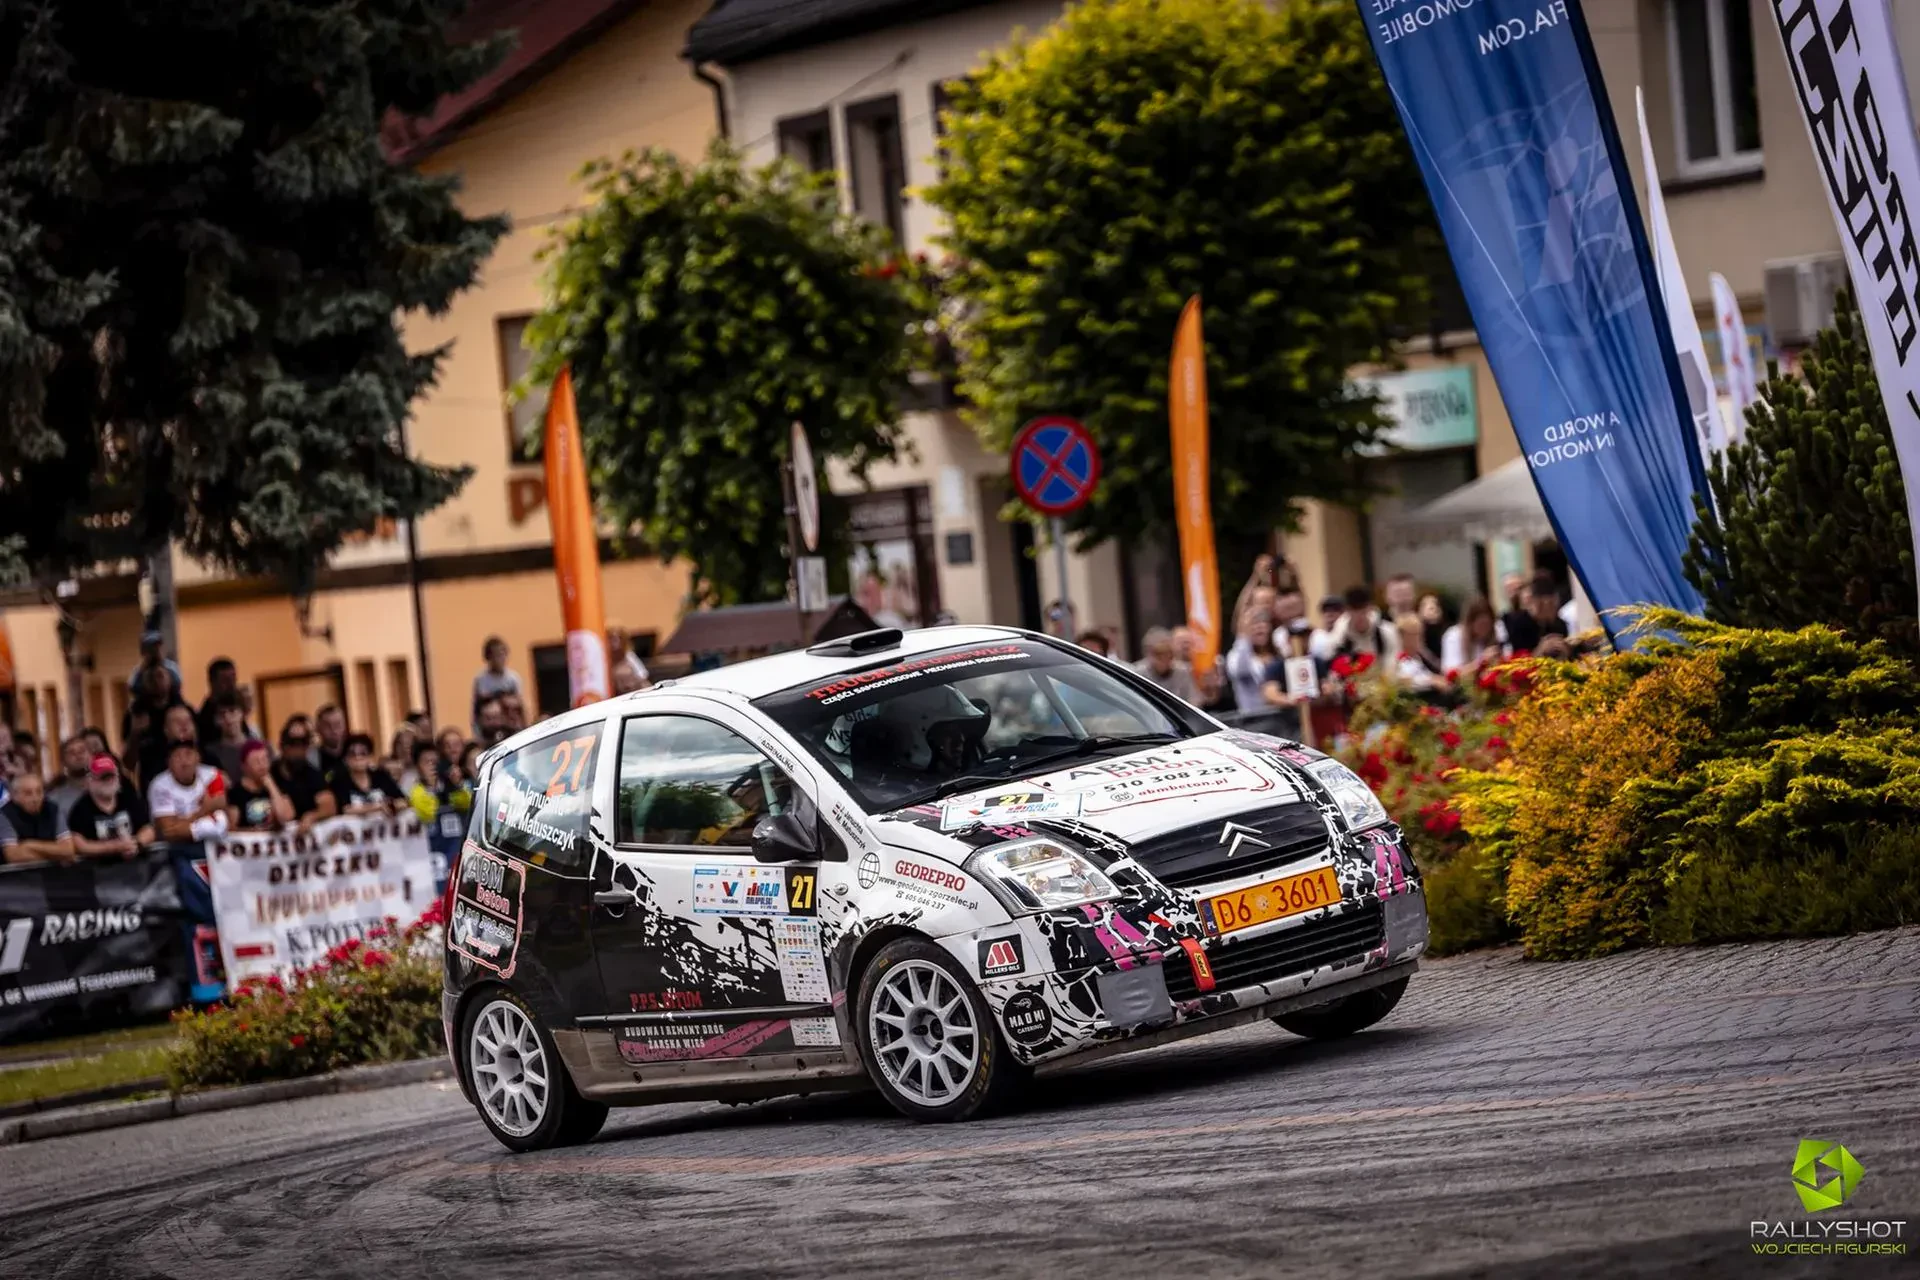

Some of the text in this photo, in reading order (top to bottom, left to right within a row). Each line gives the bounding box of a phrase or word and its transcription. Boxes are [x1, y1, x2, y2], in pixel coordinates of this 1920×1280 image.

[807, 668, 894, 698] TRUCK
[546, 734, 596, 798] 27
[1070, 755, 1168, 781] ABM
[1104, 766, 1237, 792] 510 308 235
[1107, 759, 1204, 778] beton
[998, 793, 1031, 806] 27
[1138, 778, 1229, 797] abmbeton.pl
[518, 813, 576, 851] Matuszczyk
[466, 853, 505, 893] ABM
[895, 859, 966, 892] GEOREPRO
[476, 882, 510, 915] beton
[791, 875, 814, 908] 27
[878, 876, 978, 910] www.geodezja-zgorzelec.pl
[931, 901, 946, 911] 237
[1217, 873, 1330, 928] D6 3601
[40, 904, 143, 946] RACING
[985, 964, 1020, 976] MILLERS OILS
[624, 1026, 659, 1037] BUDOWA
[665, 1024, 700, 1036] REMONT
[702, 1022, 724, 1035] DRÓG
[1016, 1023, 1044, 1035] CATERING
